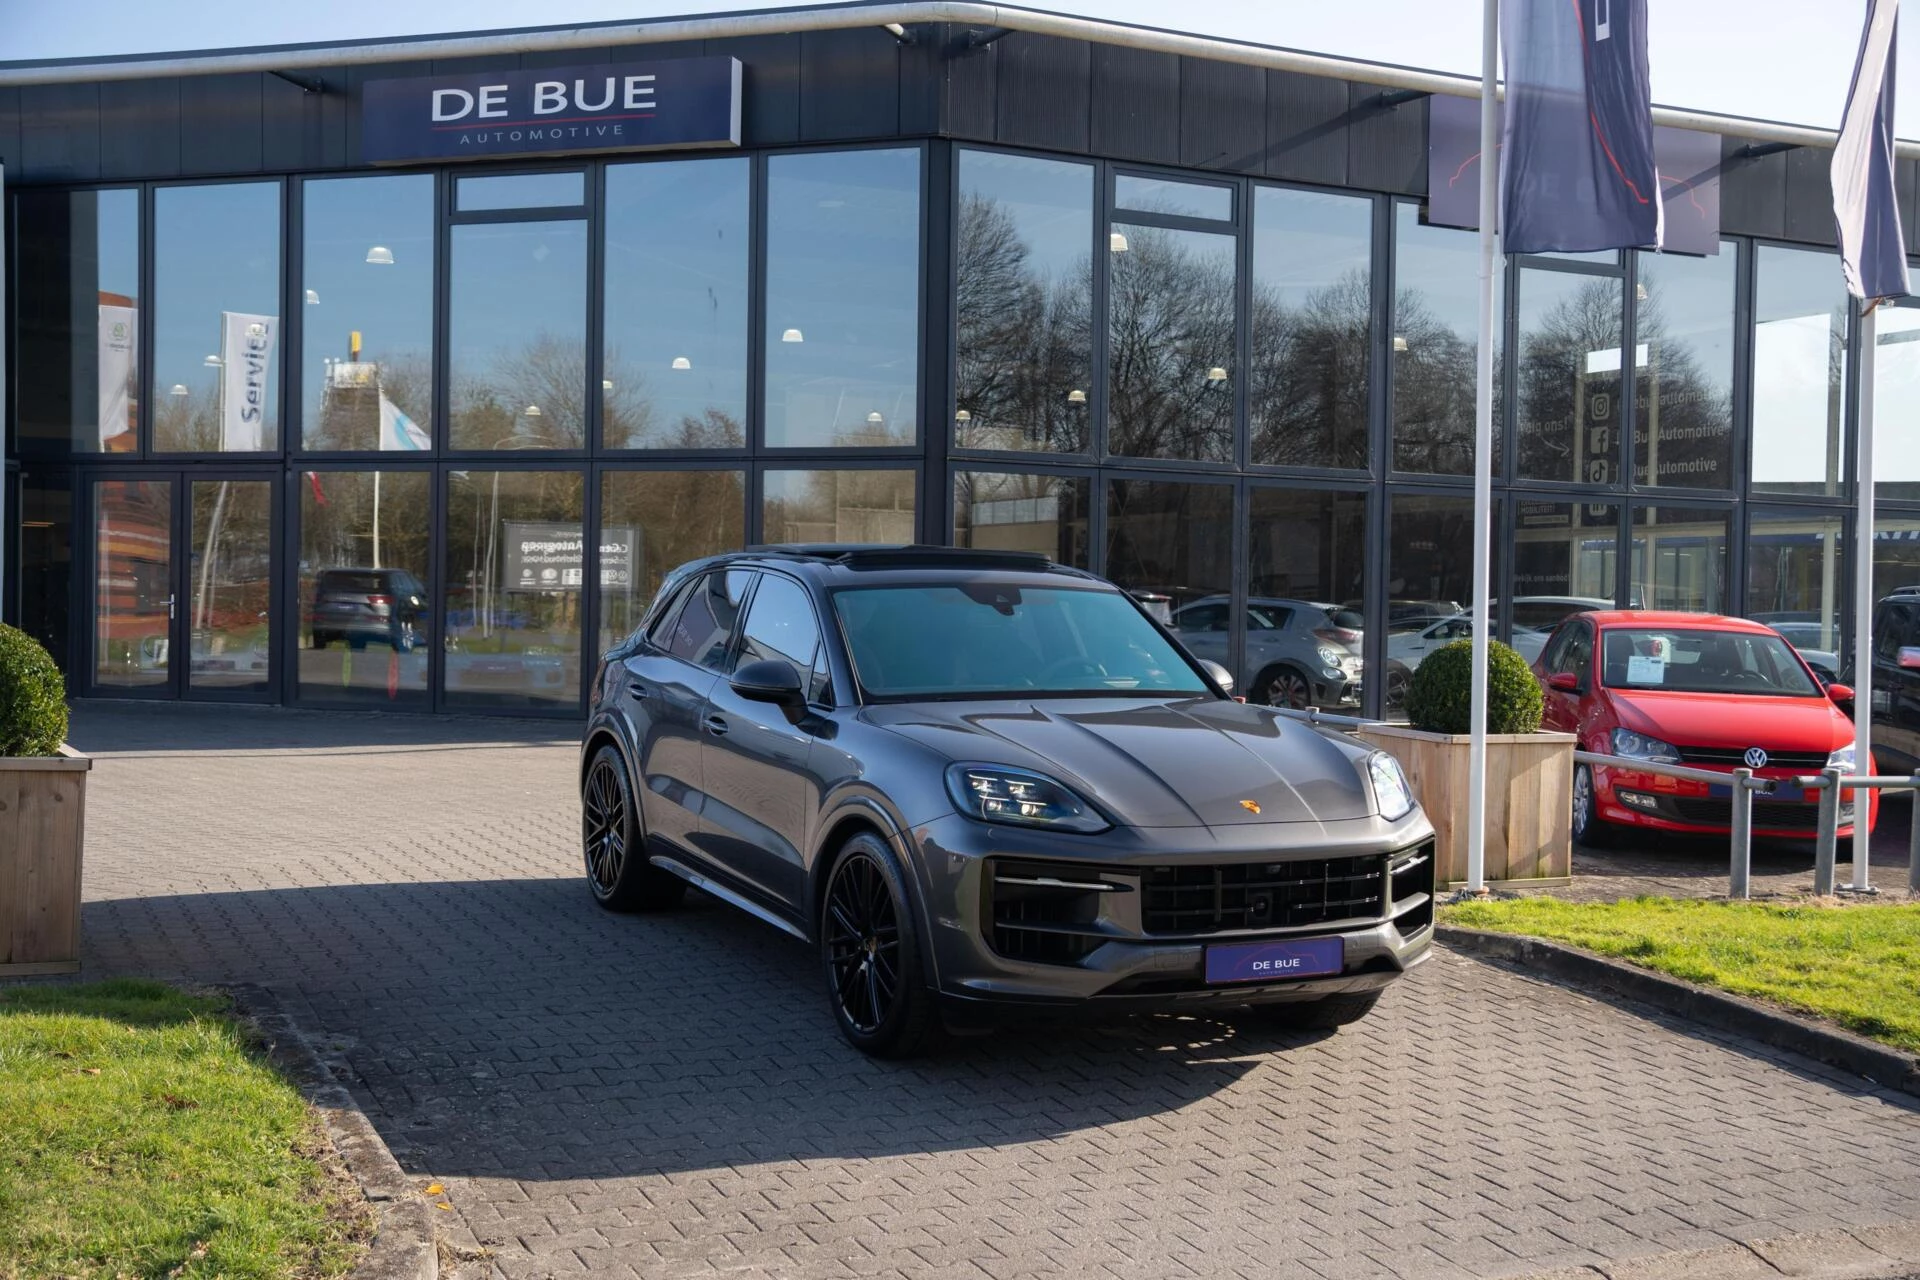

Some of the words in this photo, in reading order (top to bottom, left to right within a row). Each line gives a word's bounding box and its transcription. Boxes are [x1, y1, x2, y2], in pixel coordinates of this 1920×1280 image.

[432, 85, 509, 122] DE
[533, 75, 656, 116] BUE
[460, 124, 624, 145] AUTOMOTIVE
[1659, 422, 1724, 441] Automotive
[1656, 457, 1718, 475] utomotive
[1253, 961, 1270, 970] DE
[1275, 958, 1300, 968] BUE
